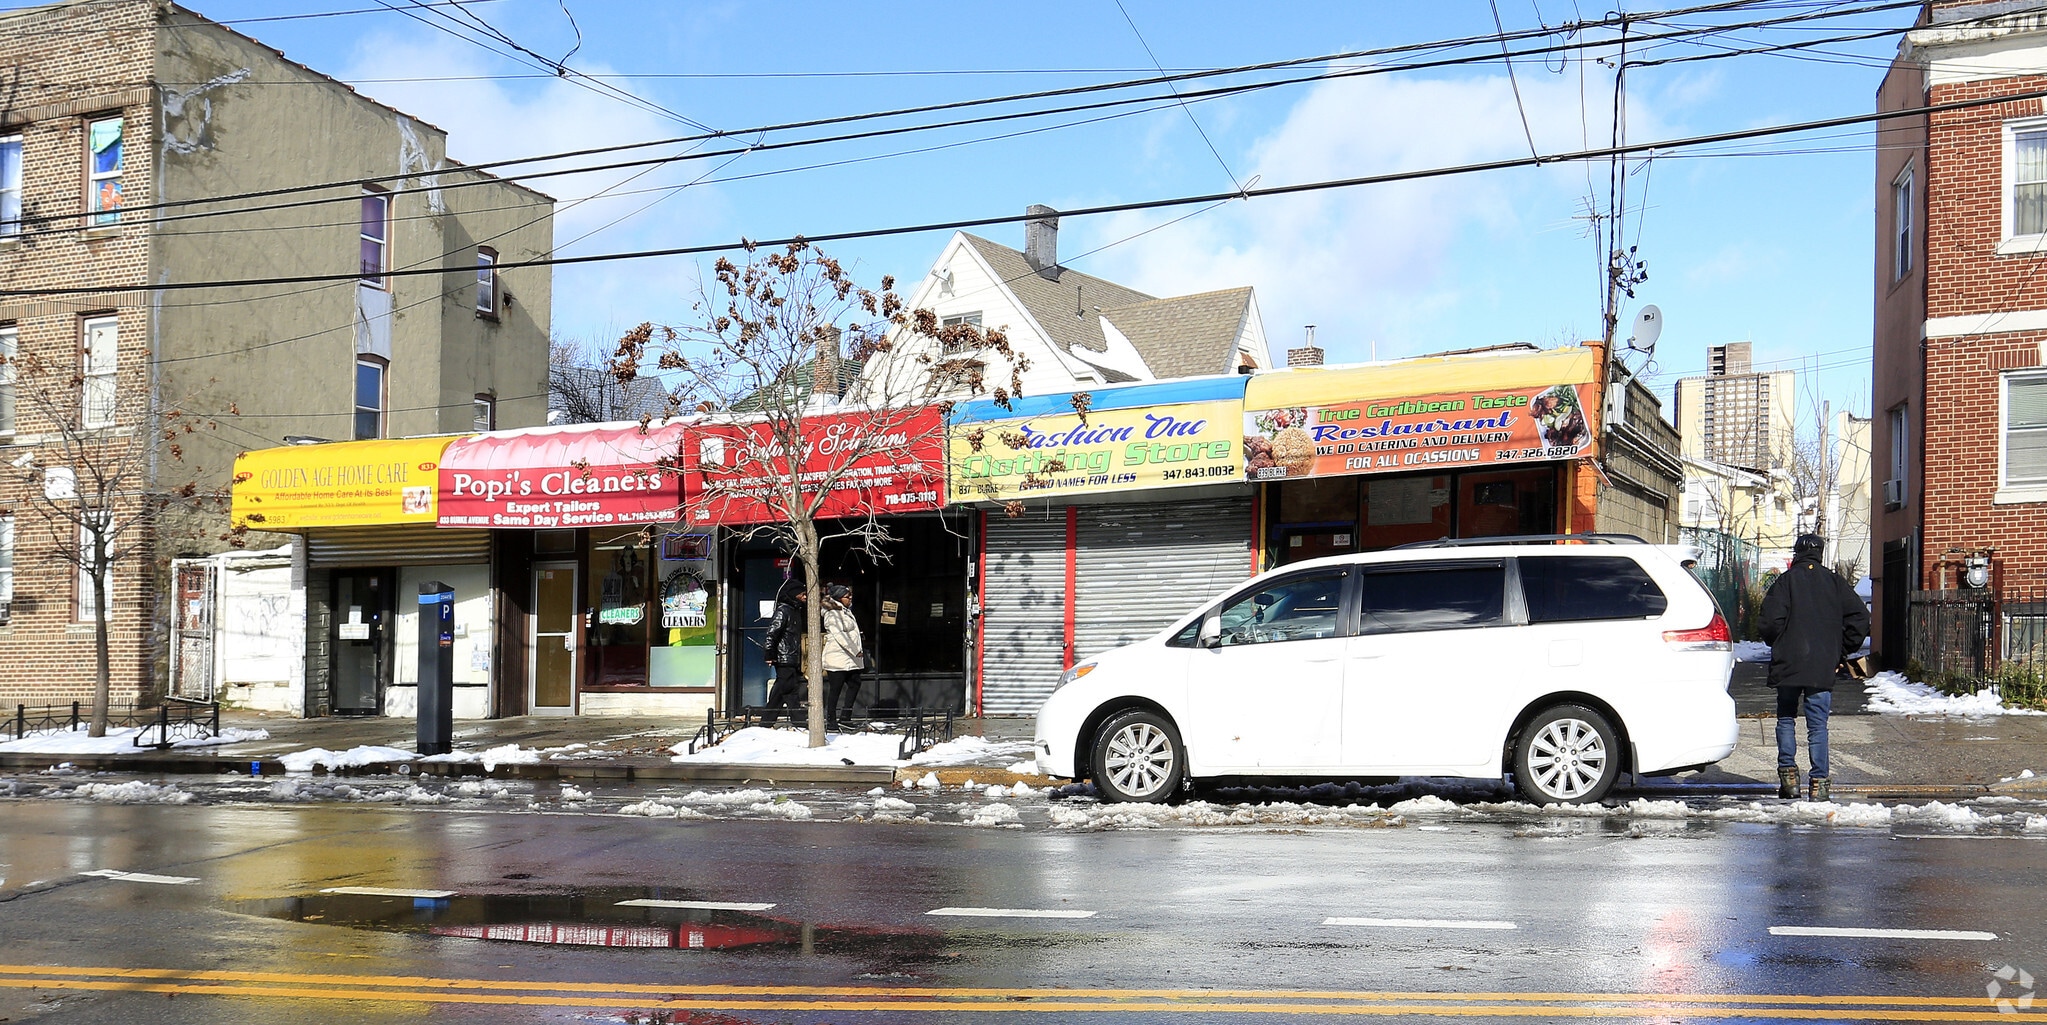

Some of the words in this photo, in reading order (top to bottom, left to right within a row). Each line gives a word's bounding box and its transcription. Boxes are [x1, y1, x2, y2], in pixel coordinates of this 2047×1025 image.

[1318, 407, 1361, 422] True
[1366, 399, 1465, 418] Caribbean
[1471, 395, 1528, 410] Taste
[1311, 410, 1518, 443] Restaurant
[1316, 445, 1335, 456] WE
[1337, 444, 1354, 455] DO
[1358, 439, 1417, 452] CATERING
[1421, 436, 1448, 447] AND
[1451, 431, 1513, 445] DELIVERY
[961, 448, 1113, 478] Clothing
[1123, 440, 1232, 466] Store
[1345, 457, 1371, 470] FOR
[1375, 454, 1400, 467] ALL
[1404, 449, 1480, 465] OCASSIONS
[1495, 445, 1579, 461] 347.326.6820
[261, 467, 308, 489] GOLDEN
[311, 466, 333, 487] AGE
[337, 464, 373, 486] HOME
[377, 462, 409, 484] CARE
[1055, 476, 1086, 488] NAMES
[1087, 474, 1108, 485] FOR
[1111, 472, 1137, 483] LESS
[1162, 465, 1236, 480] 347.843.0032
[452, 470, 531, 502] Popi's
[541, 471, 662, 495] Cleaners
[958, 485, 971, 494] 837
[274, 491, 312, 501] Affordable
[313, 491, 335, 500] Home
[336, 489, 353, 499] Care
[355, 489, 363, 498] At
[375, 488, 392, 496] Best
[506, 502, 551, 516] Expert
[554, 500, 600, 513] Tailors
[493, 512, 532, 526] Same
[534, 513, 559, 528] Day
[562, 510, 613, 524] Service
[443, 604, 450, 619] P
[601, 608, 639, 619] CLEANERS
[663, 615, 706, 627] CLEANERS
